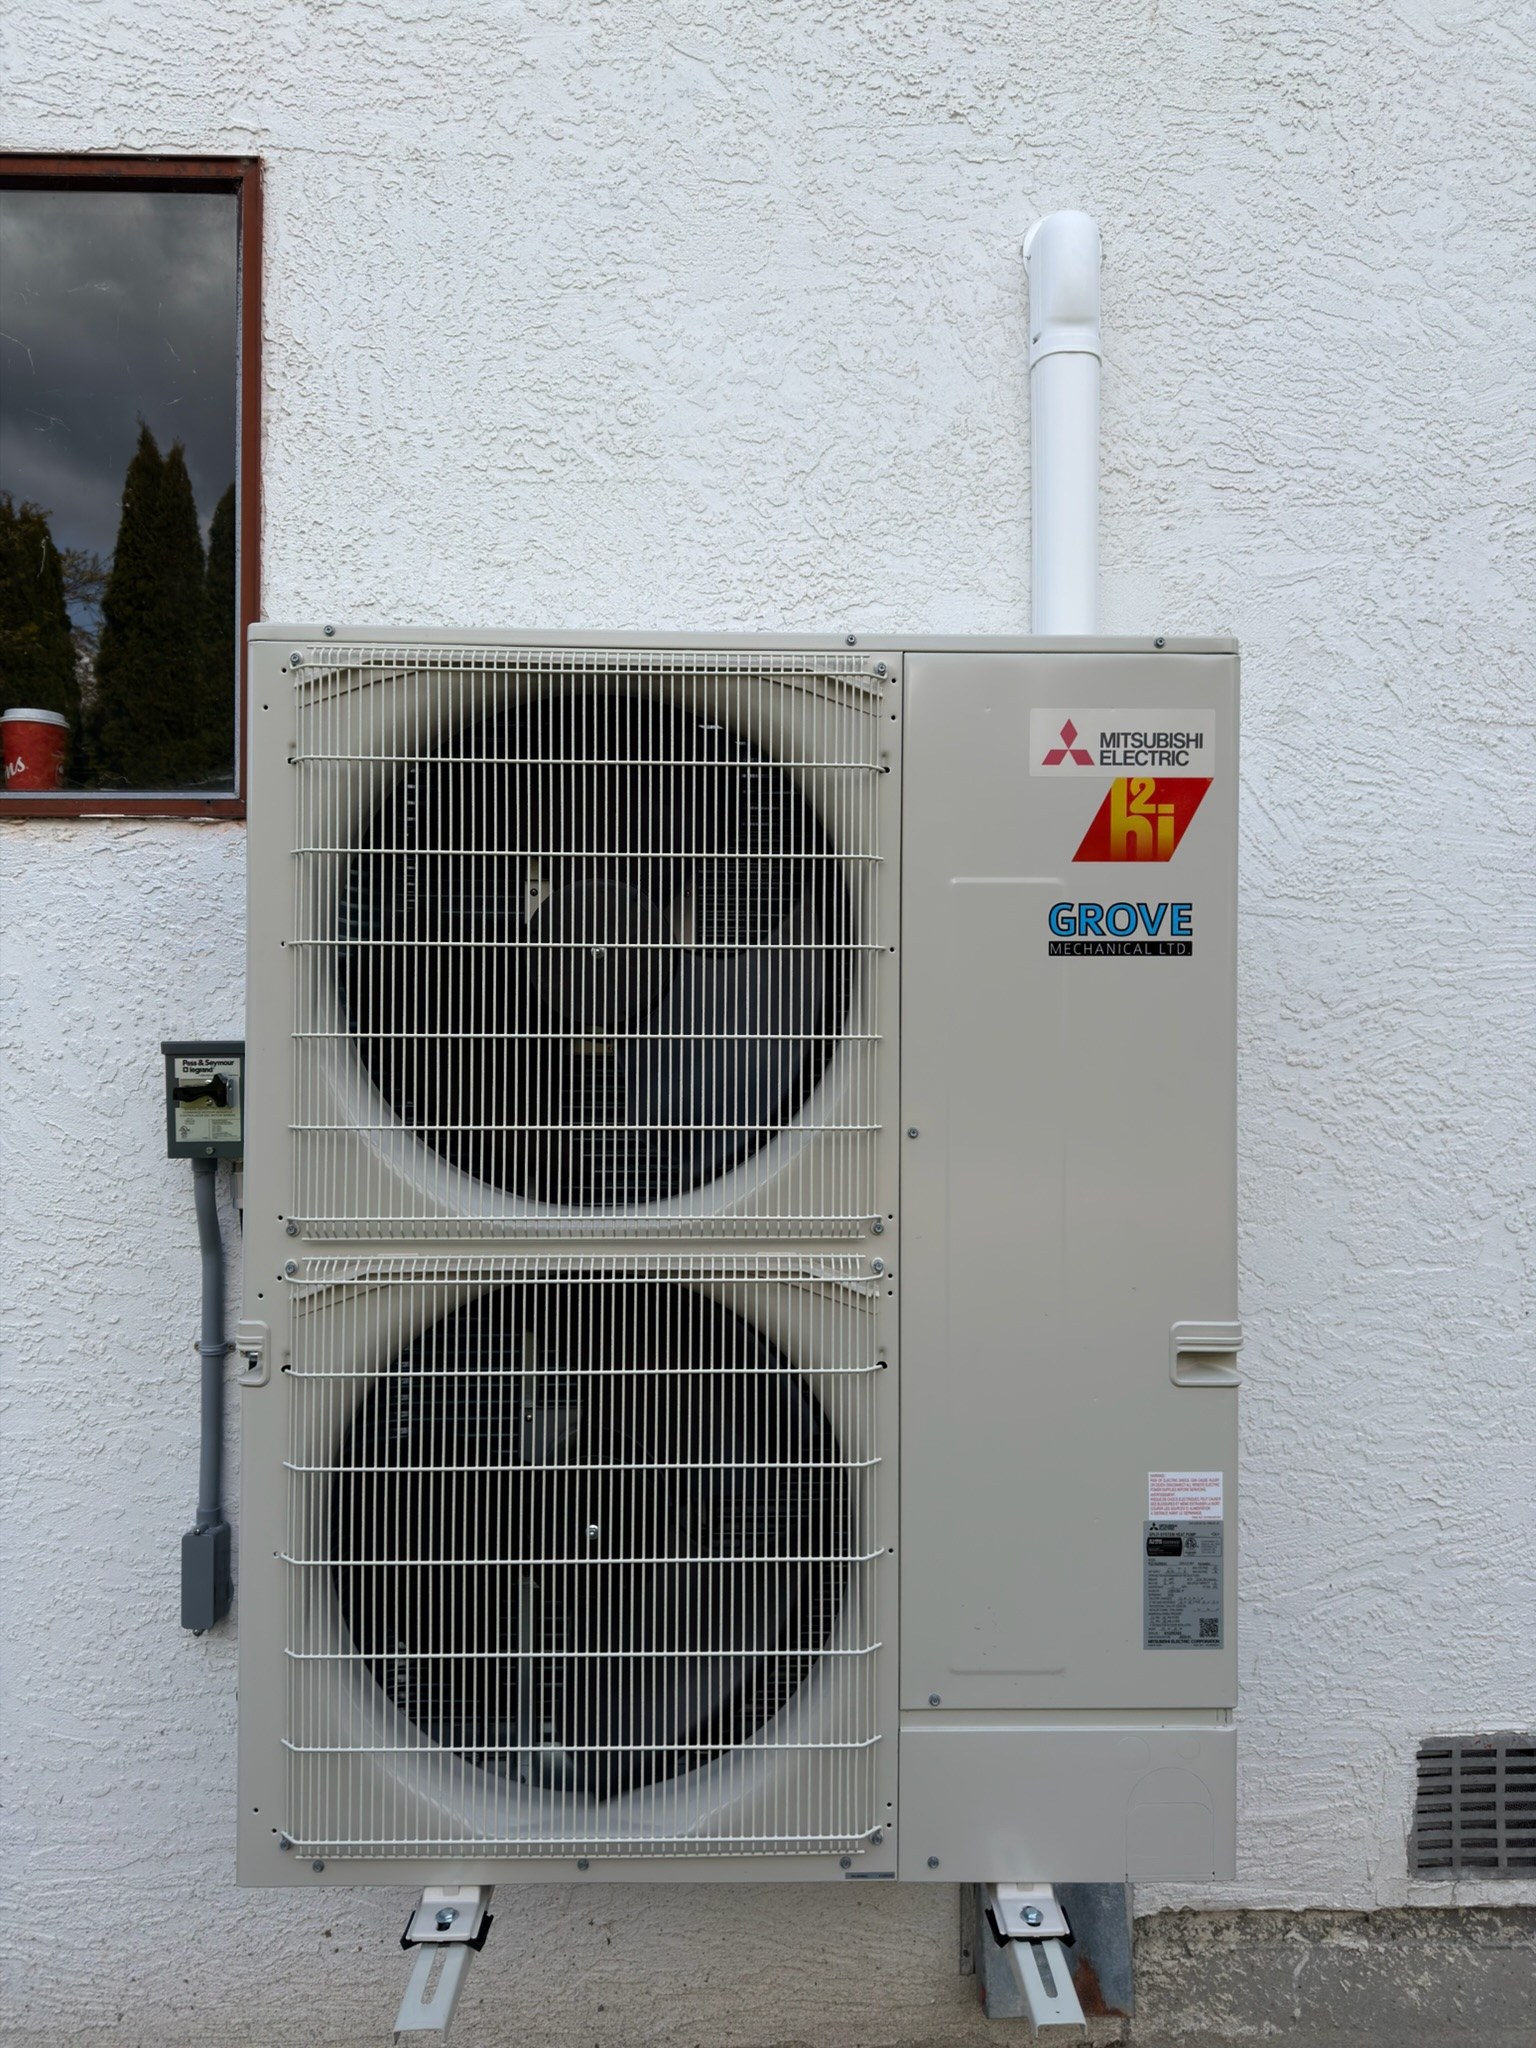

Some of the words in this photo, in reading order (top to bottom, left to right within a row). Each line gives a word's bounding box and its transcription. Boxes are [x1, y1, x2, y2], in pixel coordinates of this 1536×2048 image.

[1100, 732, 1203, 749] MITSUBISHI
[1100, 750, 1190, 766] ELECTRIC
[1048, 901, 1193, 937] GROVE
[1050, 943, 1152, 955] MECHANICAL
[1159, 943, 1191, 955] LTD.
[205, 1059, 235, 1068] Seymour
[190, 1067, 213, 1075] legrand
